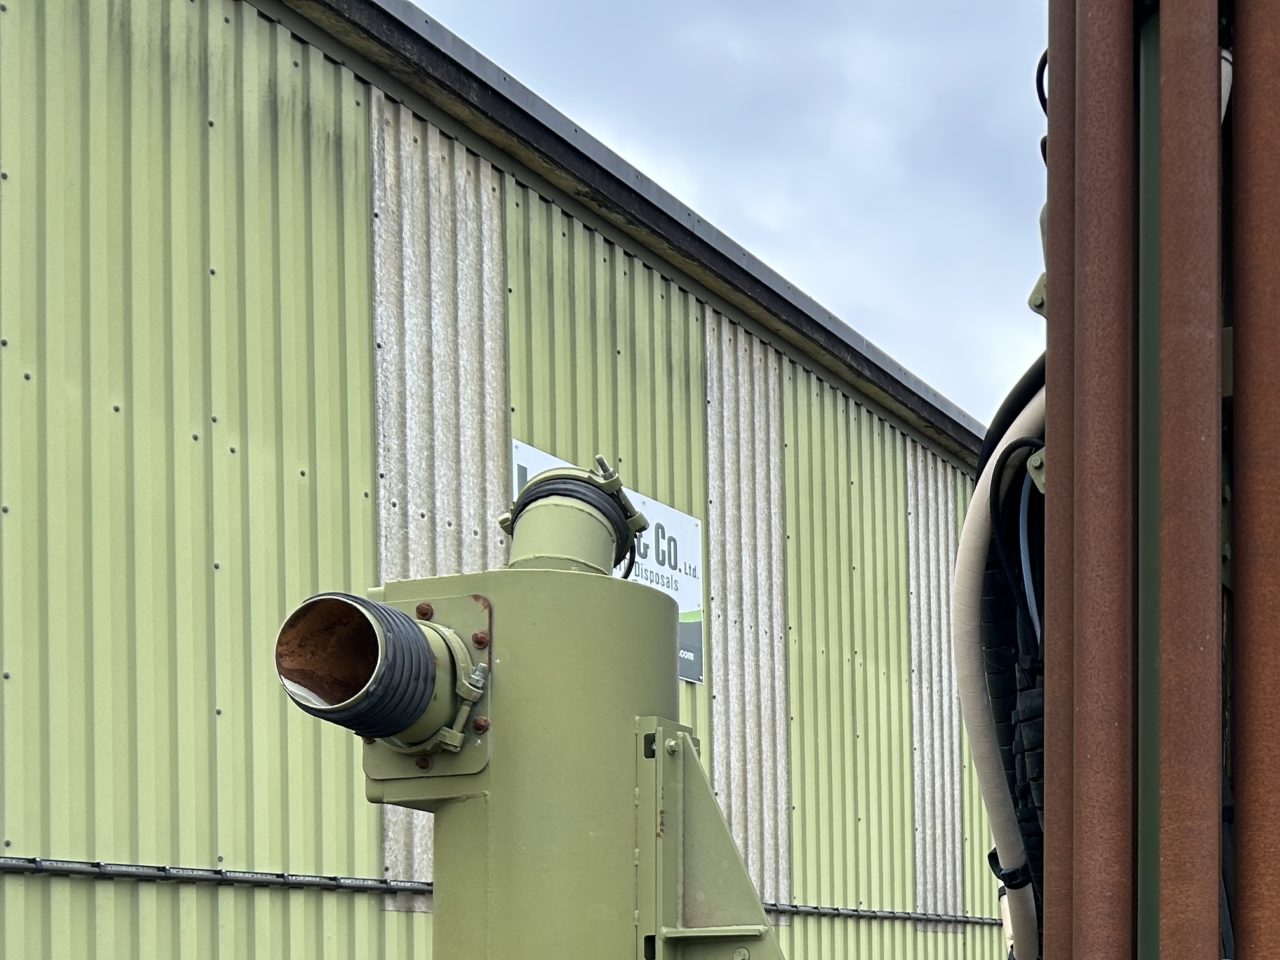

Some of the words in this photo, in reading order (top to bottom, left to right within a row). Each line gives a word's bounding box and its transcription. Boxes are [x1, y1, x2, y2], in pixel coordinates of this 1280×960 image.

[654, 522, 682, 571] Co.
[684, 561, 699, 580] Ltd.
[634, 560, 679, 592] Disposals
